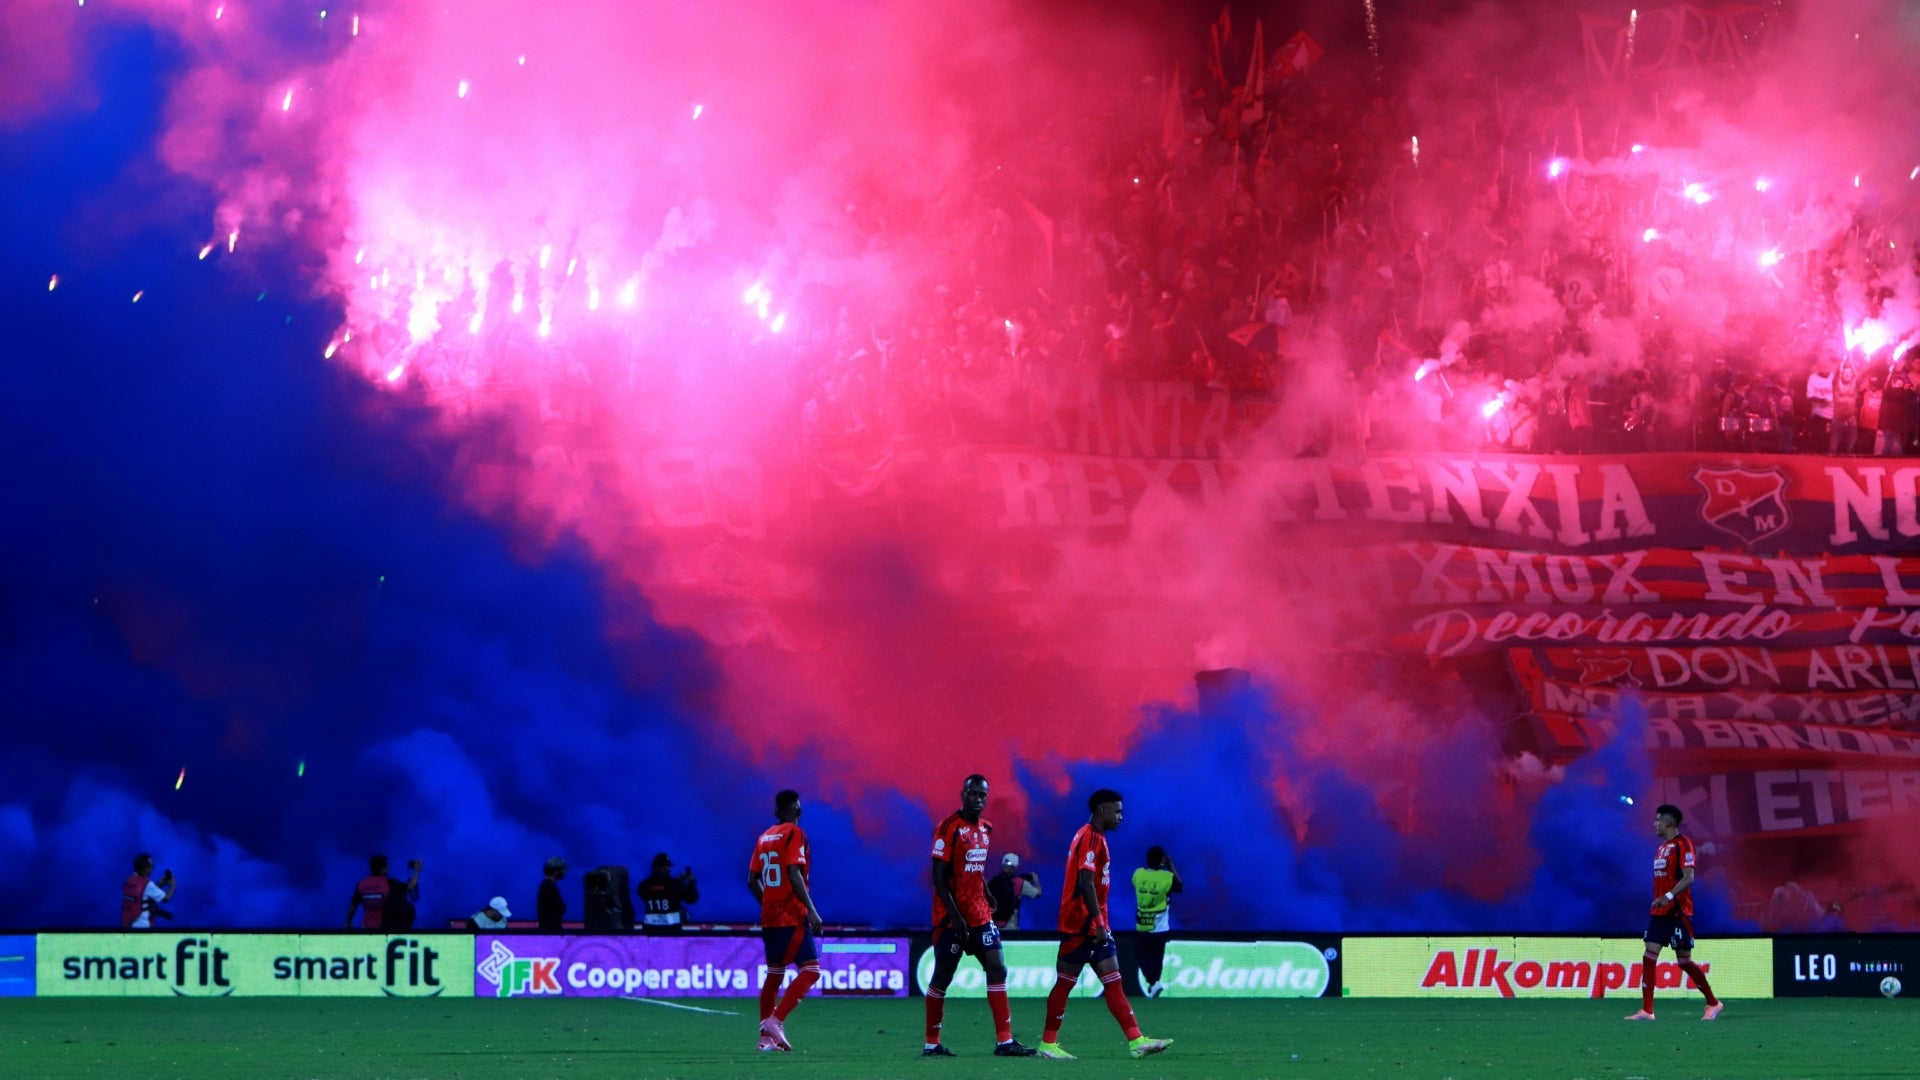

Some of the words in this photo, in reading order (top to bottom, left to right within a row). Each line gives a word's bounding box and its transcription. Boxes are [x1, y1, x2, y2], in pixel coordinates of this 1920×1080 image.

[1692, 551, 1836, 607] EN
[1412, 604, 1802, 658] Decorando
[1646, 646, 1781, 688] DON
[647, 898, 670, 911] 118
[1674, 926, 1683, 940] 4
[63, 953, 167, 980] smart
[175, 938, 231, 987] fit
[273, 953, 377, 980] smart
[385, 938, 441, 987] fit
[497, 958, 561, 998] JFK
[567, 962, 738, 992] Cooperativa
[1794, 953, 1837, 981] LEO
